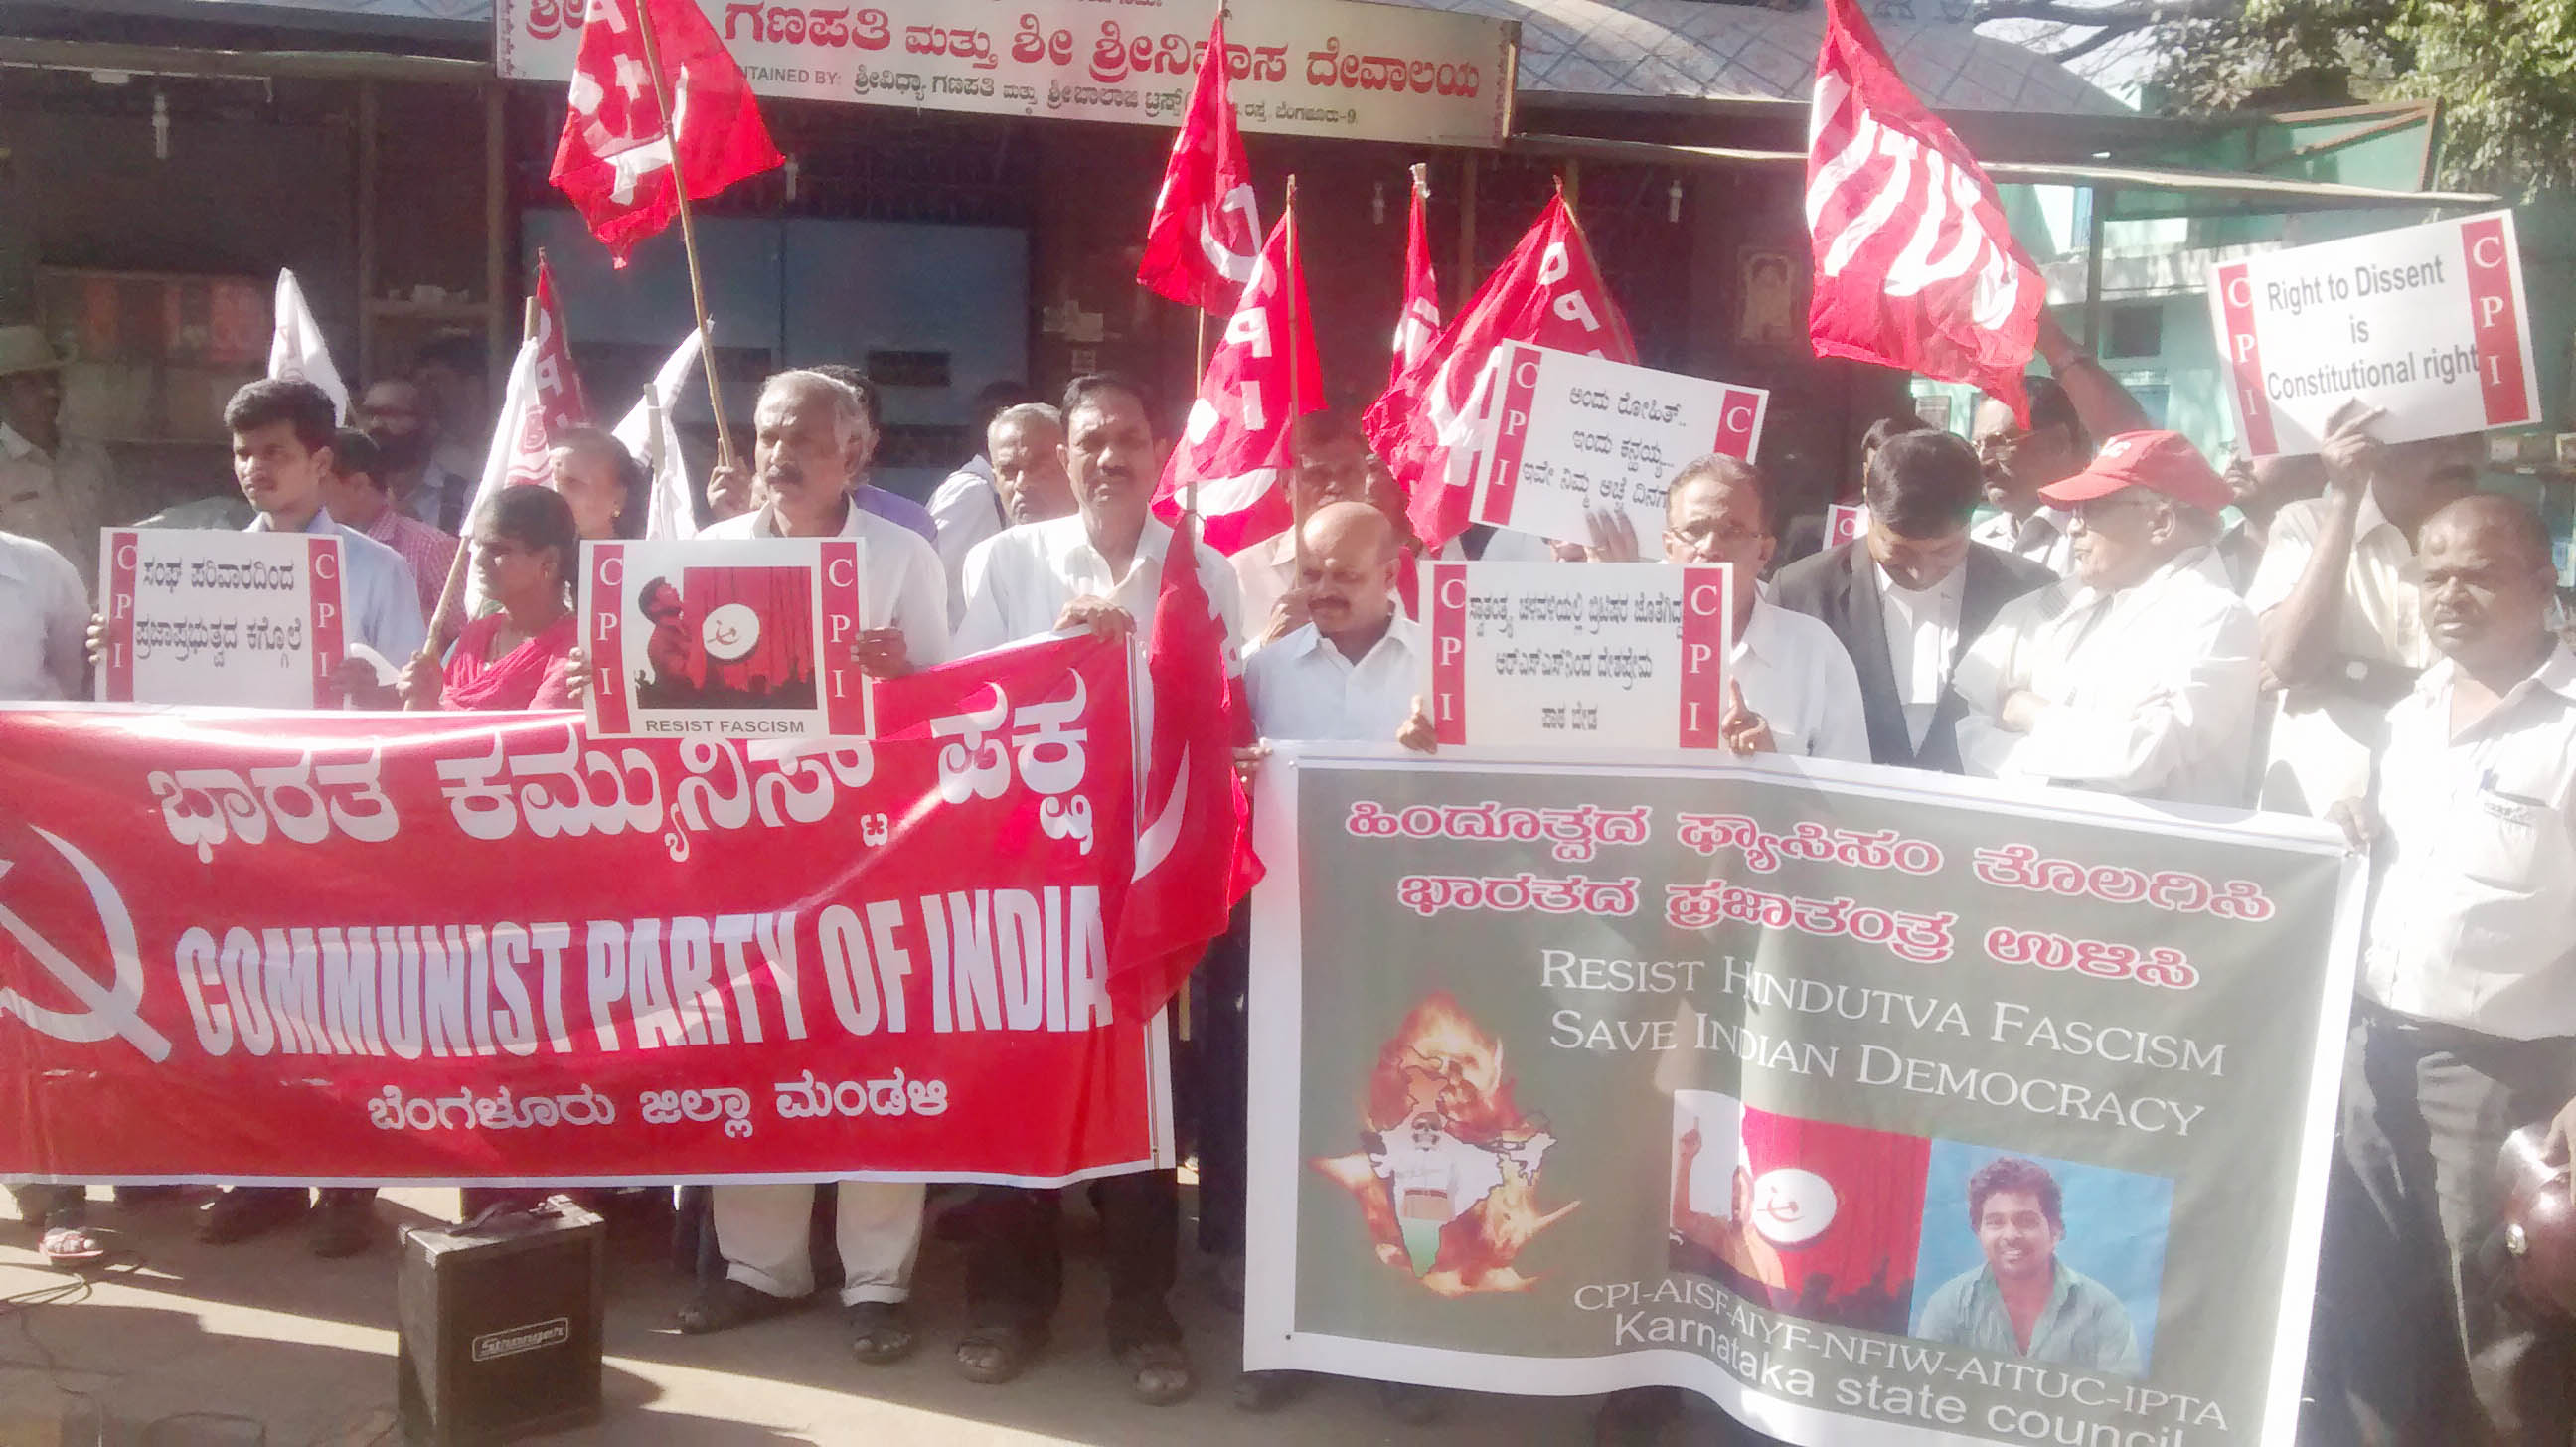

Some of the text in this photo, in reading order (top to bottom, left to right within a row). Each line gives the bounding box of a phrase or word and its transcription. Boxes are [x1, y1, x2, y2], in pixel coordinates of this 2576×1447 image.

[724, 1, 891, 51] ಗಣಪತಿ
[904, 23, 998, 69] ಮತ್ತು
[1306, 36, 1480, 98] ದೇವಾಲಯ
[931, 74, 995, 97] ಗಣಪತಿ
[2267, 255, 2446, 316] Right to Dissent
[2349, 314, 2370, 345] is
[2267, 343, 2481, 401] Constitutional right
[191, 557, 295, 591] ಪರಿವಾರದಿಂದ
[147, 736, 400, 864] ಭಾರತ
[930, 668, 1094, 855] ಪಕ್ಷ
[646, 720, 805, 733] RESIST FASCISM
[1346, 800, 2276, 922] ಹಿಂದೂತ್ವದ ಫ್ಯಾಸಿಸಂ ತೊಲಗಿಸಿ
[175, 884, 1114, 1059] COMMUNIST PARTY OF INDIA
[1397, 873, 2200, 990] ಭಾರತದ ಪ್ರಜಾತಂತ್ರ ಉಳಿಸಿ
[1540, 949, 2227, 1077] RESIST HINDUTVA FASCISM
[368, 1067, 949, 1138] ಬೆಂಗಳೂರು ಜಿಲ್ಲಾ ಮಂಡಳಿ
[1550, 1009, 2206, 1137] SAVE INDIAN DEMOCRACY
[1613, 1310, 1816, 1399] Karnataka
[1836, 1369, 1967, 1424] state
